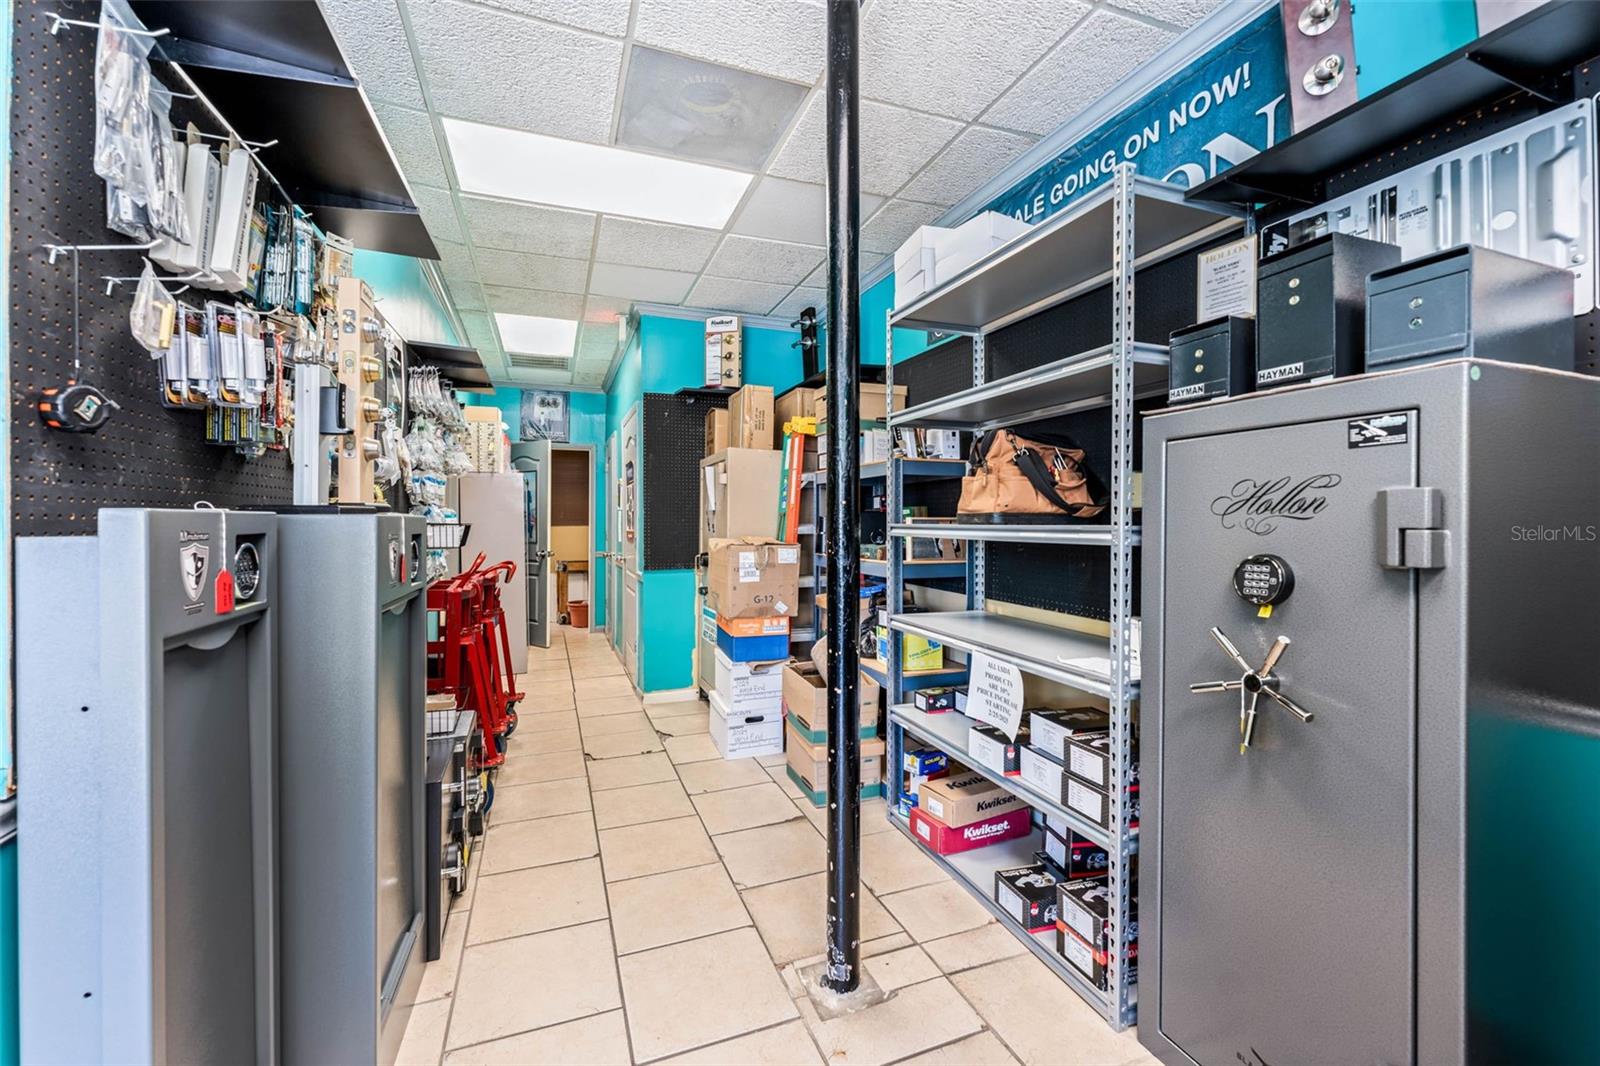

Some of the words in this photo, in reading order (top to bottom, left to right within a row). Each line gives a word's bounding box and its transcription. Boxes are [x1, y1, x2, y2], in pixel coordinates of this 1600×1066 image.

[1008, 193, 1045, 225] ALE
[1050, 150, 1117, 204] GOING
[1124, 120, 1160, 159] ON
[1168, 62, 1251, 133] NOW!
[1260, 364, 1302, 381] HAYMAN
[1170, 384, 1204, 399] HAYMAN
[1211, 473, 1342, 535] Hollon
[753, 595, 774, 604] G-12
[987, 661, 996, 670] ALL
[984, 671, 1013, 688] PRODUCTS
[988, 682, 999, 692] ARE
[976, 686, 993, 698] PRICE
[994, 693, 1018, 711] INCREASE
[985, 699, 1012, 717] STARTING
[946, 776, 985, 790] Kwik
[976, 794, 1017, 812] Kwikset
